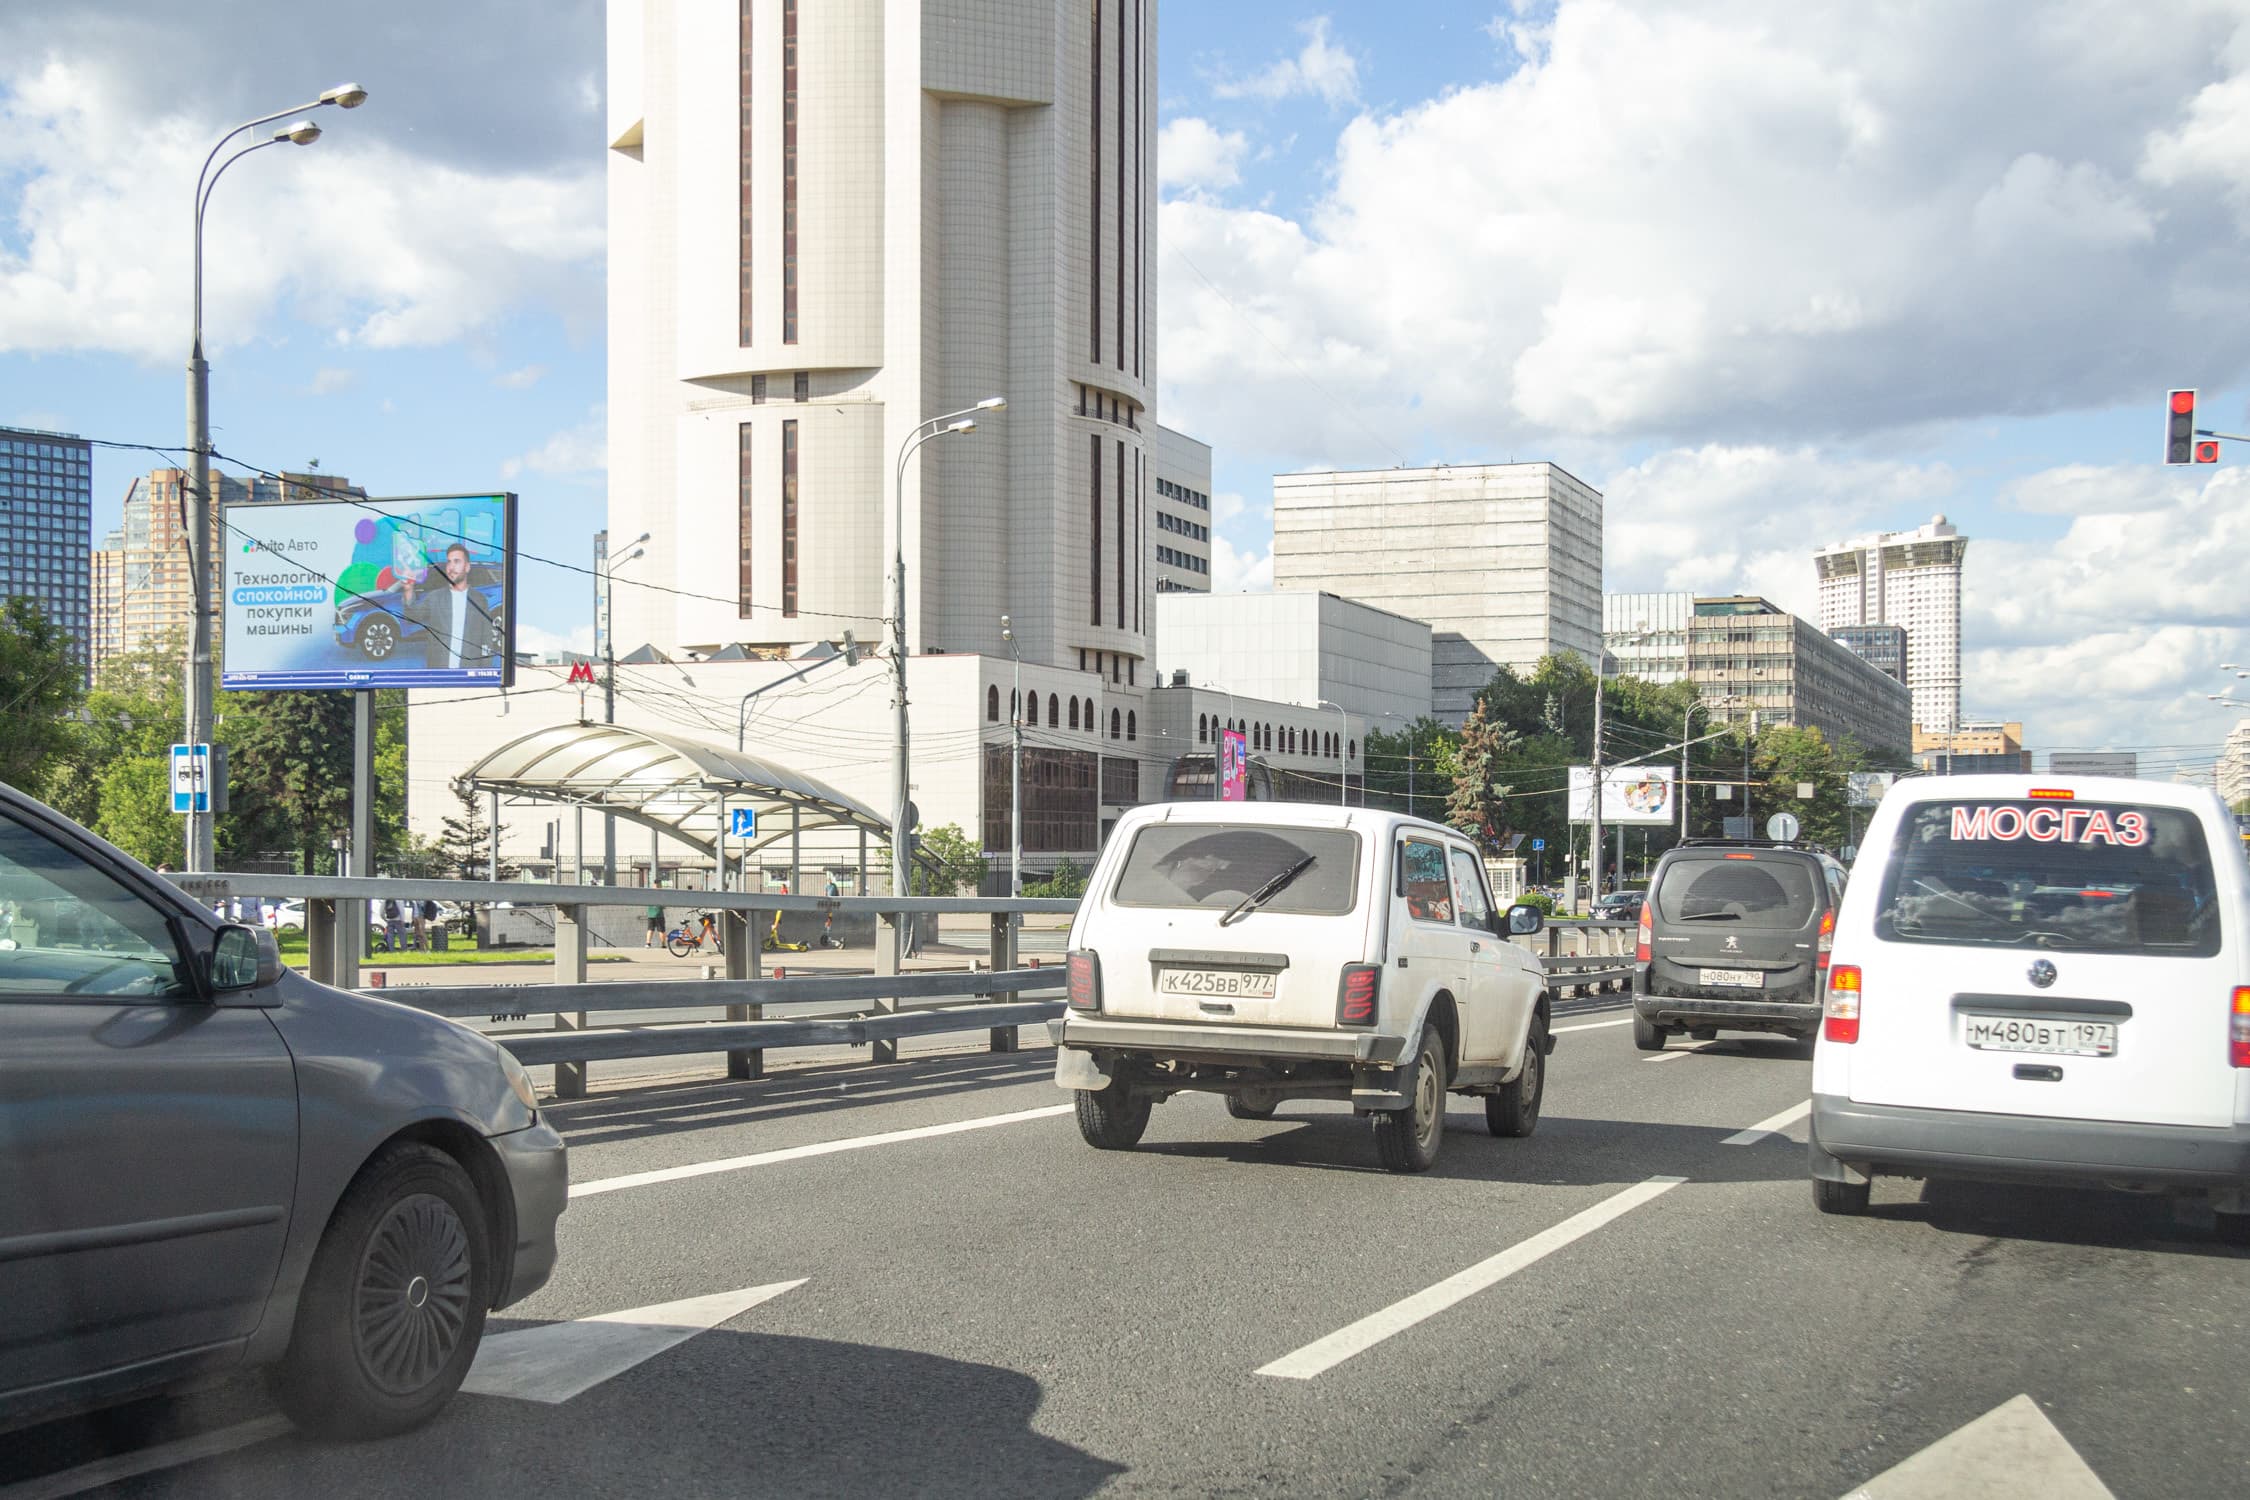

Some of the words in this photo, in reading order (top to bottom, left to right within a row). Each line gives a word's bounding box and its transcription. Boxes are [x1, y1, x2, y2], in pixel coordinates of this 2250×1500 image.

[256, 540, 285, 552] Avito
[234, 571, 327, 585] Технологии
[236, 586, 323, 602] спокойной
[247, 607, 313, 621] покупки
[246, 624, 313, 635] машины
[567, 660, 596, 684] М
[1950, 806, 2149, 847] МОСГАЗ
[1168, 972, 1239, 993] К425ВВ
[1243, 974, 1271, 990] 977
[1974, 1021, 2066, 1046] М480ВТ
[2073, 1025, 2107, 1042] 197
